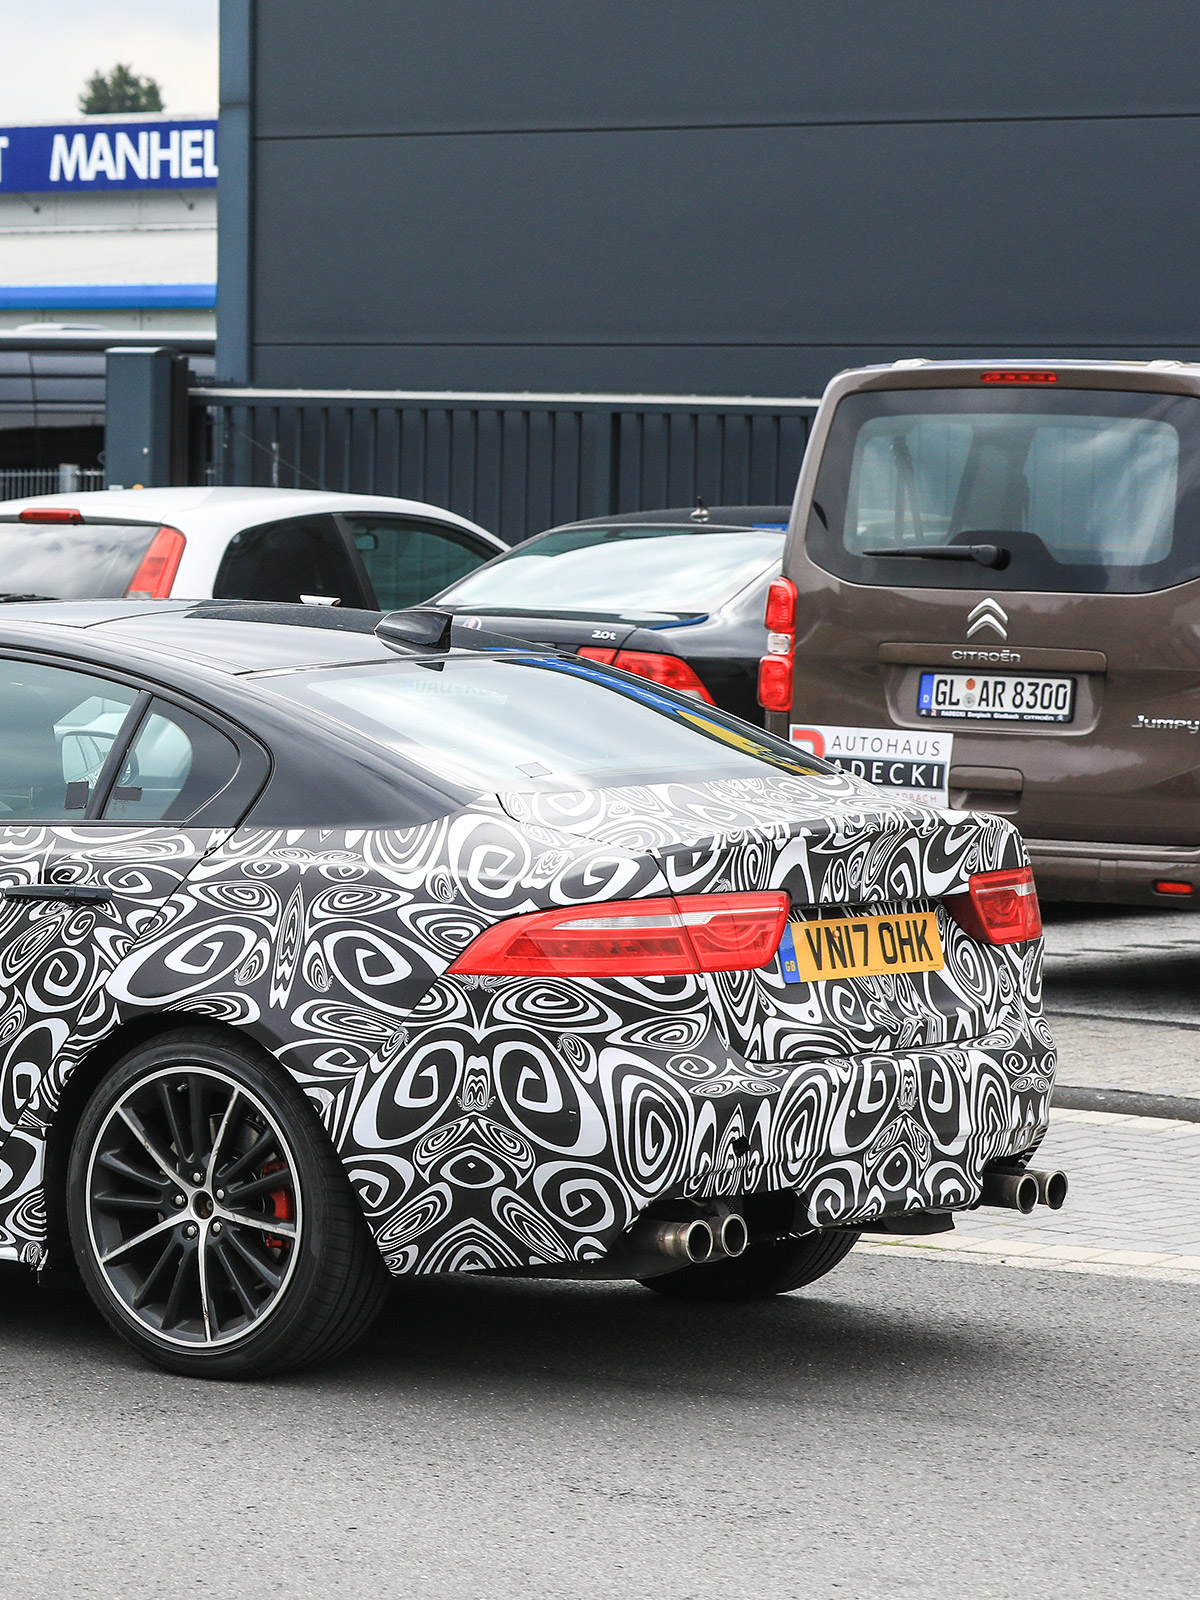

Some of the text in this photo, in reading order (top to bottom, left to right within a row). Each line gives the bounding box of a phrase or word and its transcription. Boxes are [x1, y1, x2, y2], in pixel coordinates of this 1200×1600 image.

[50, 129, 218, 182] MANHEL
[935, 679, 1068, 710] GL AR 8300
[1131, 715, 1200, 734] Jumpy
[831, 735, 941, 757] AUTOHAUS
[804, 919, 934, 971] VN17 OHK
[785, 960, 797, 972] GB
